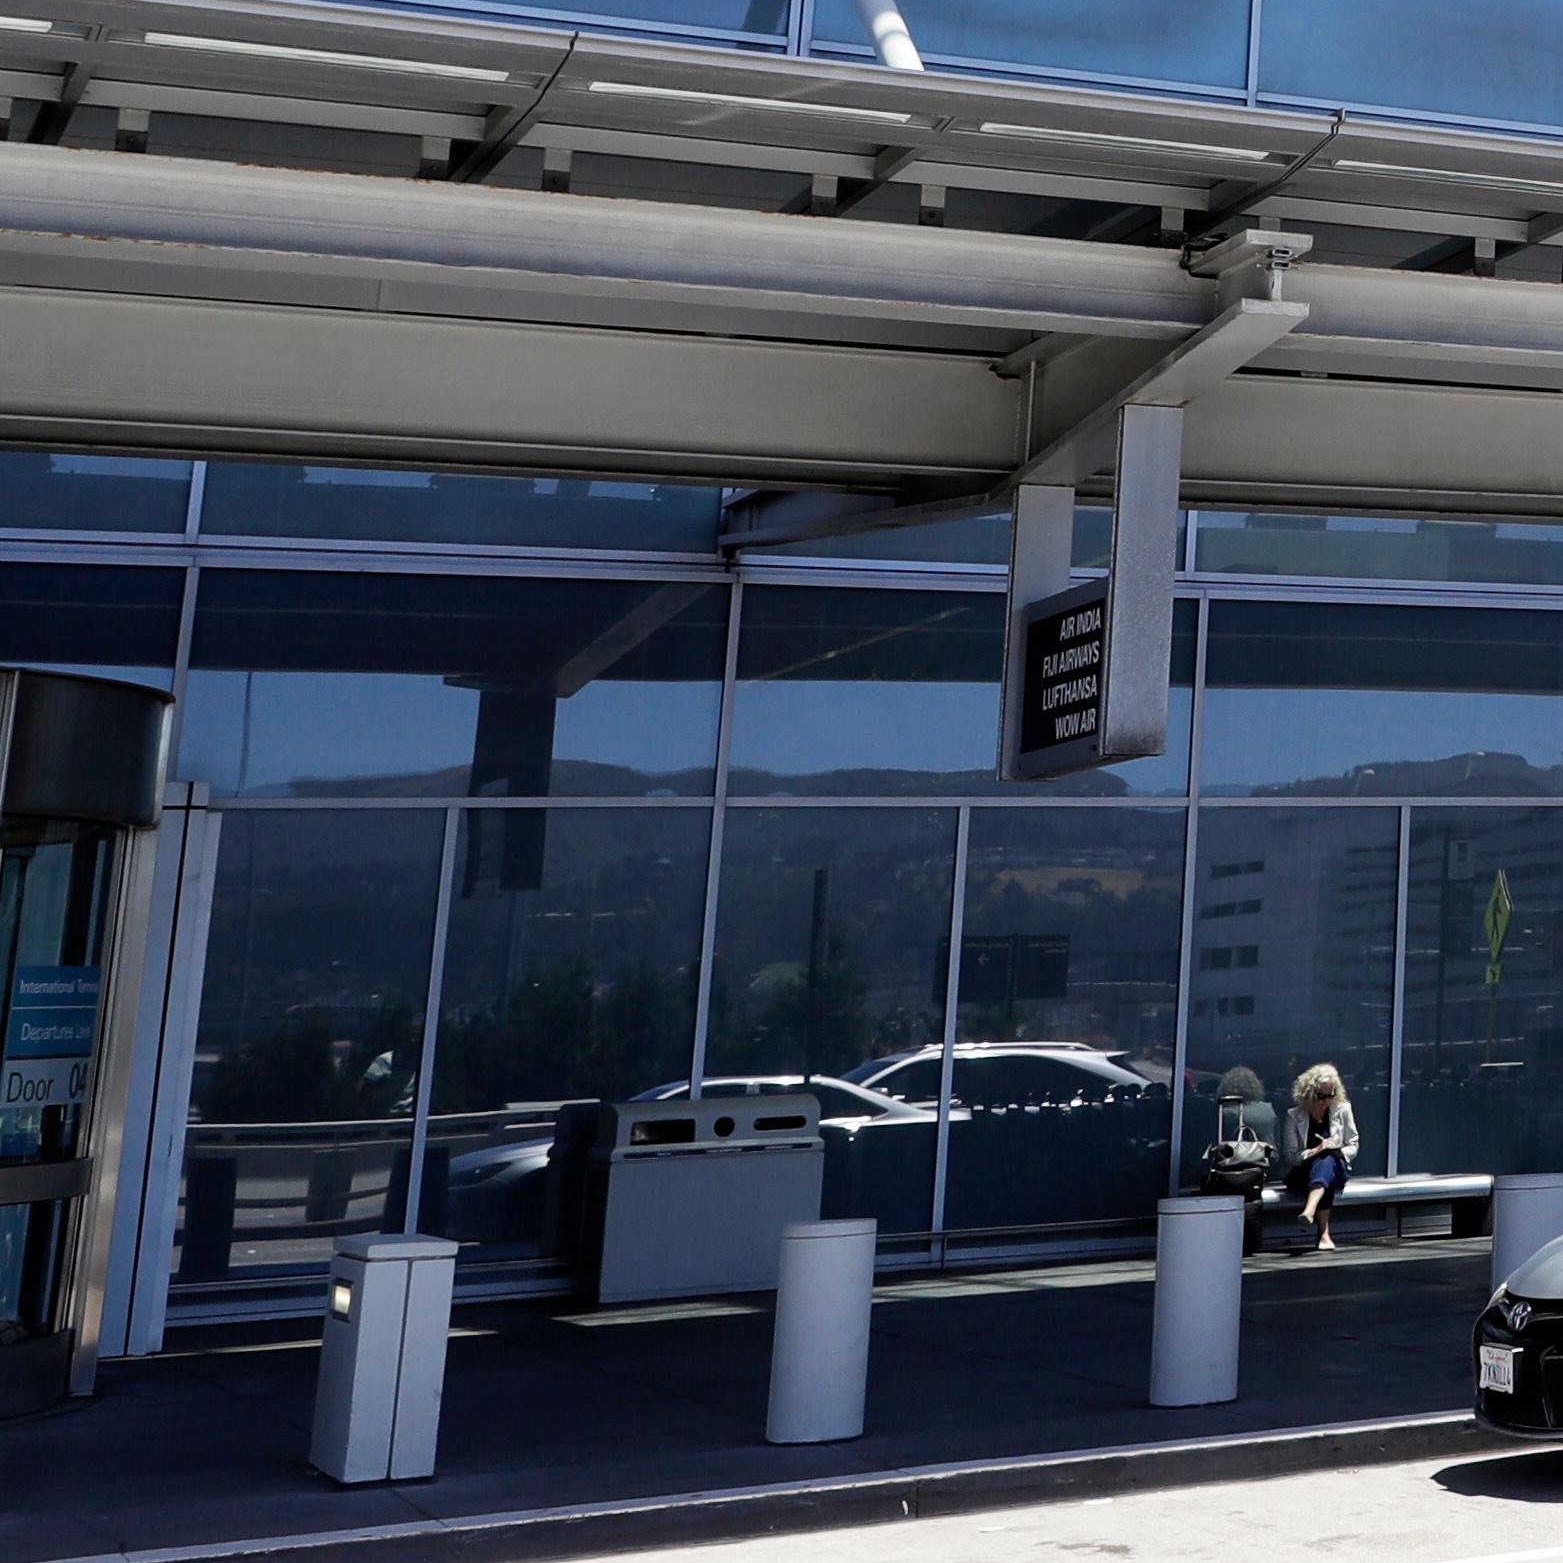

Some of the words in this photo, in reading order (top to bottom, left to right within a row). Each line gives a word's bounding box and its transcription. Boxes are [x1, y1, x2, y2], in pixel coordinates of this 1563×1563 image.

[1059, 615, 1075, 641] AIR
[1076, 607, 1101, 636] INDIA
[1042, 654, 1058, 678] FIJI
[1058, 640, 1100, 673] AIRWAYS
[1042, 674, 1098, 711] LUFTHANSA
[1055, 712, 1081, 740] WOW
[1080, 707, 1096, 734] AIR
[20, 979, 75, 995] International
[20, 1023, 74, 1045] Departures
[6, 1072, 55, 1103] Door
[69, 1062, 88, 1099] 04
